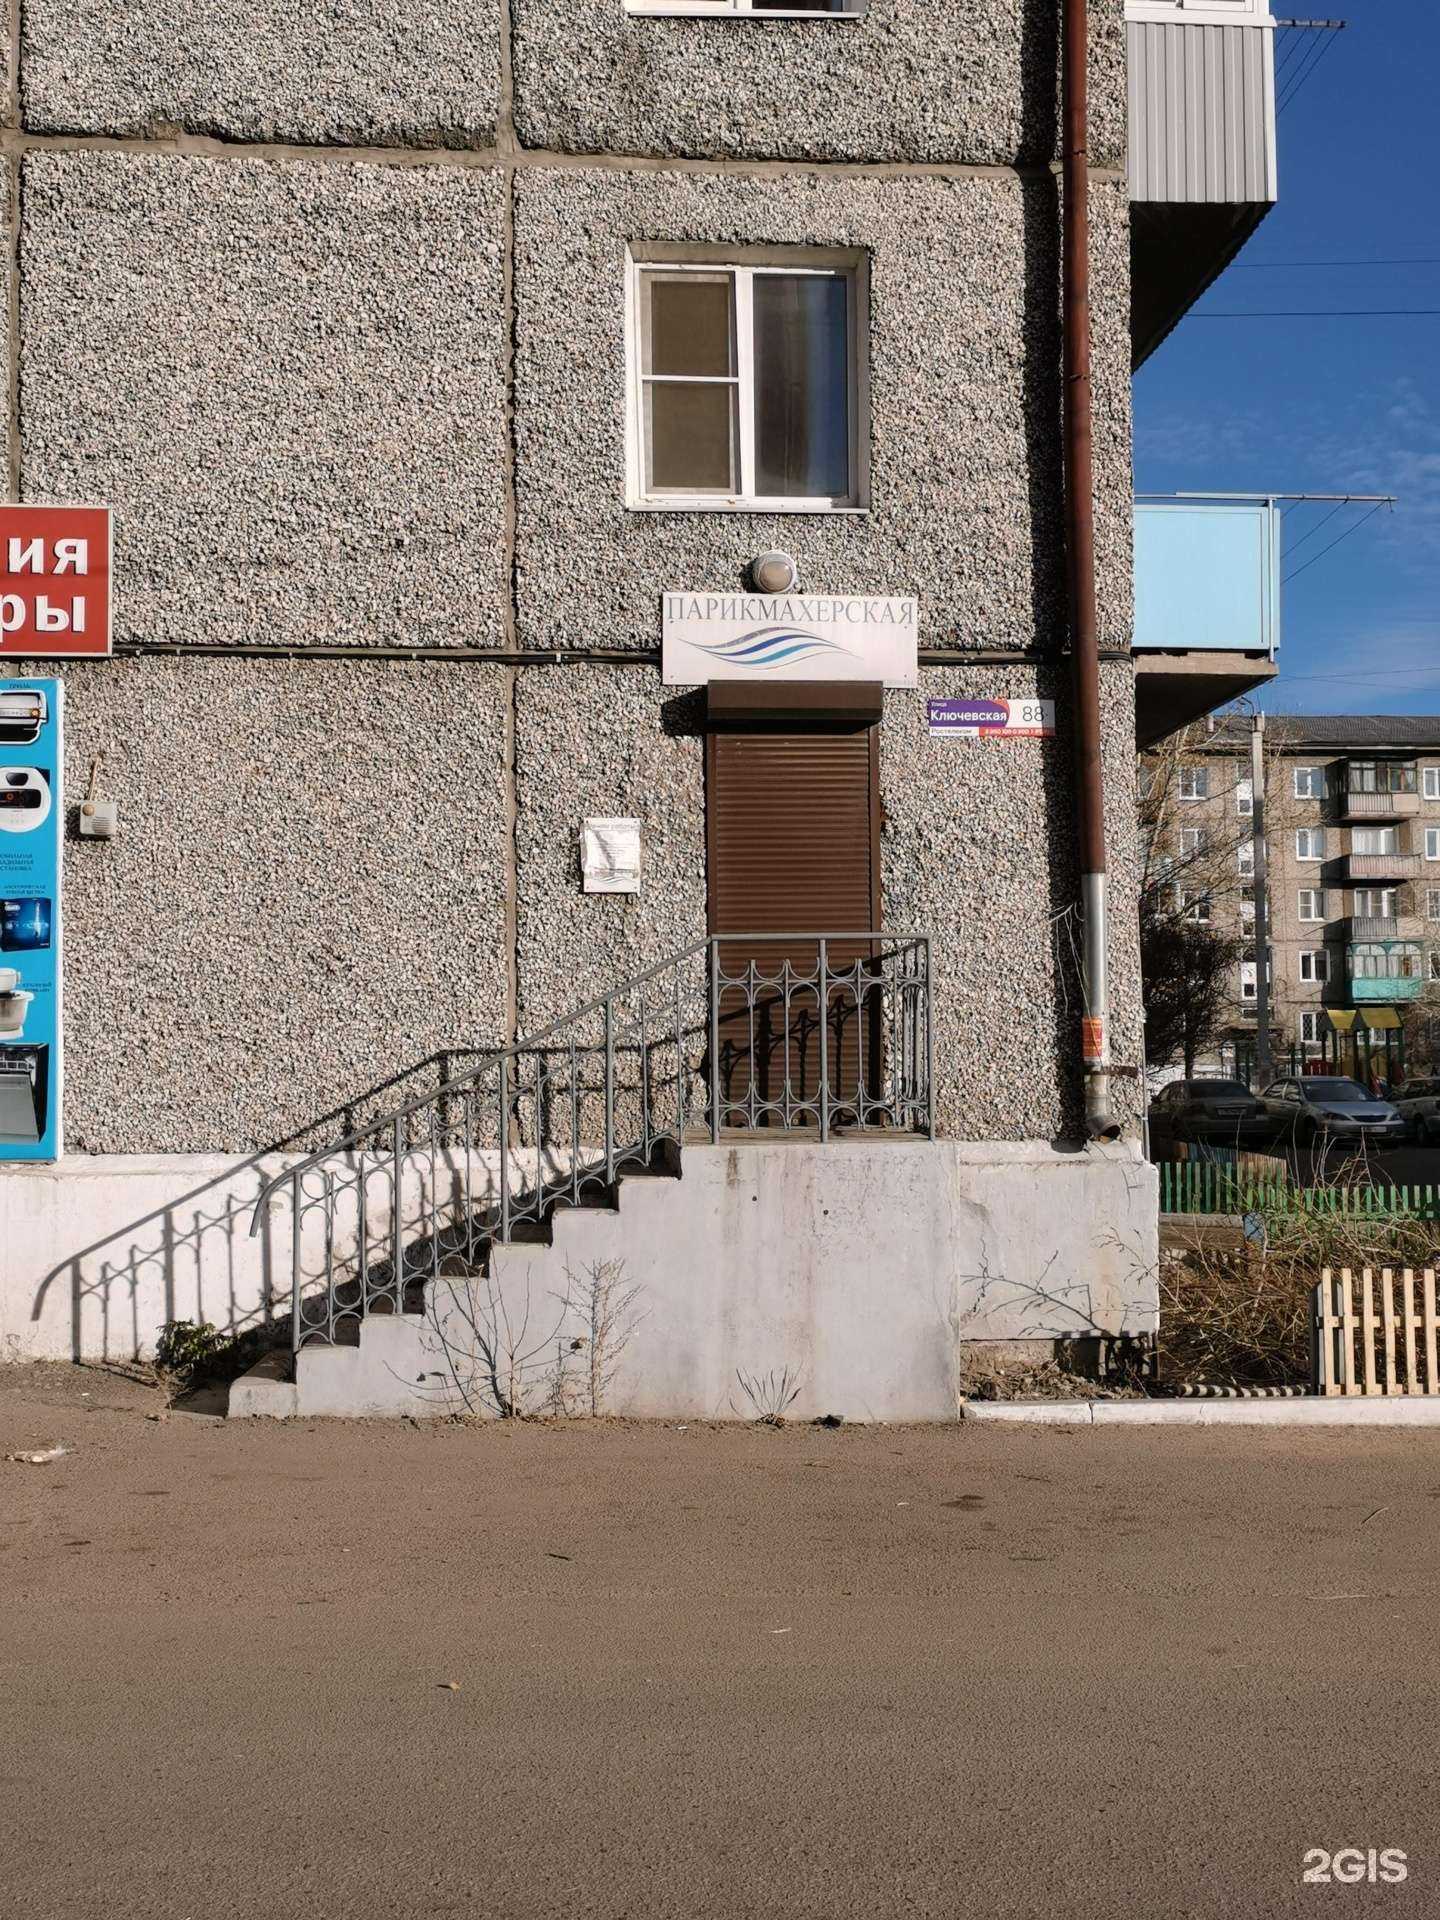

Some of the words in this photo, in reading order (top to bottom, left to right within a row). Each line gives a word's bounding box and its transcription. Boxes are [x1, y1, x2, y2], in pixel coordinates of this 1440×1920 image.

[8, 537, 88, 575] ия
[667, 596, 914, 624] ПАРИКМАХЕРСКАЯ
[930, 709, 1007, 721] Ключевская
[1022, 706, 1044, 722] 88
